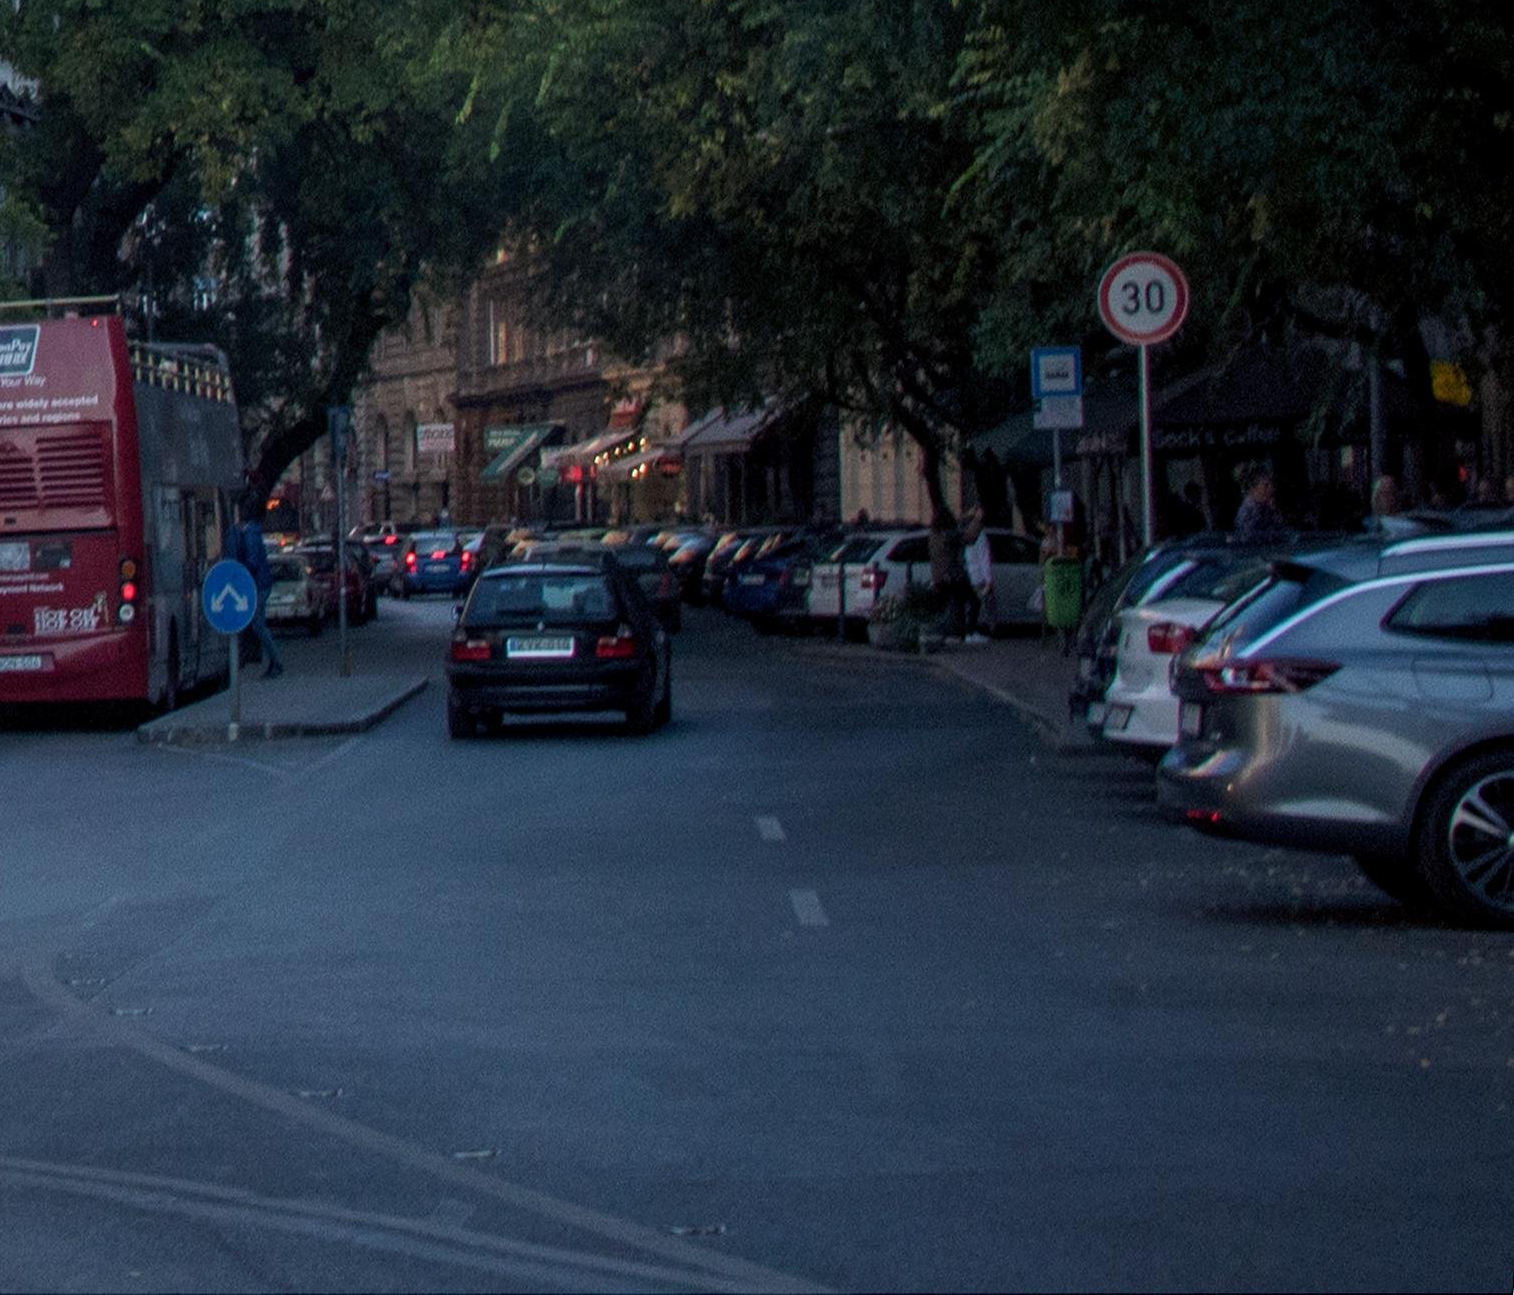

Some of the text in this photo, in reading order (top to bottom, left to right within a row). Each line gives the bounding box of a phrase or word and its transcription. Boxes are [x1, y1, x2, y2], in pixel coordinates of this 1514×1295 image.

[1121, 280, 1165, 315] 30
[24, 375, 46, 388] Way
[15, 398, 49, 410] widely
[51, 395, 98, 409] accepted
[20, 413, 40, 424] and
[42, 411, 81, 424] regions
